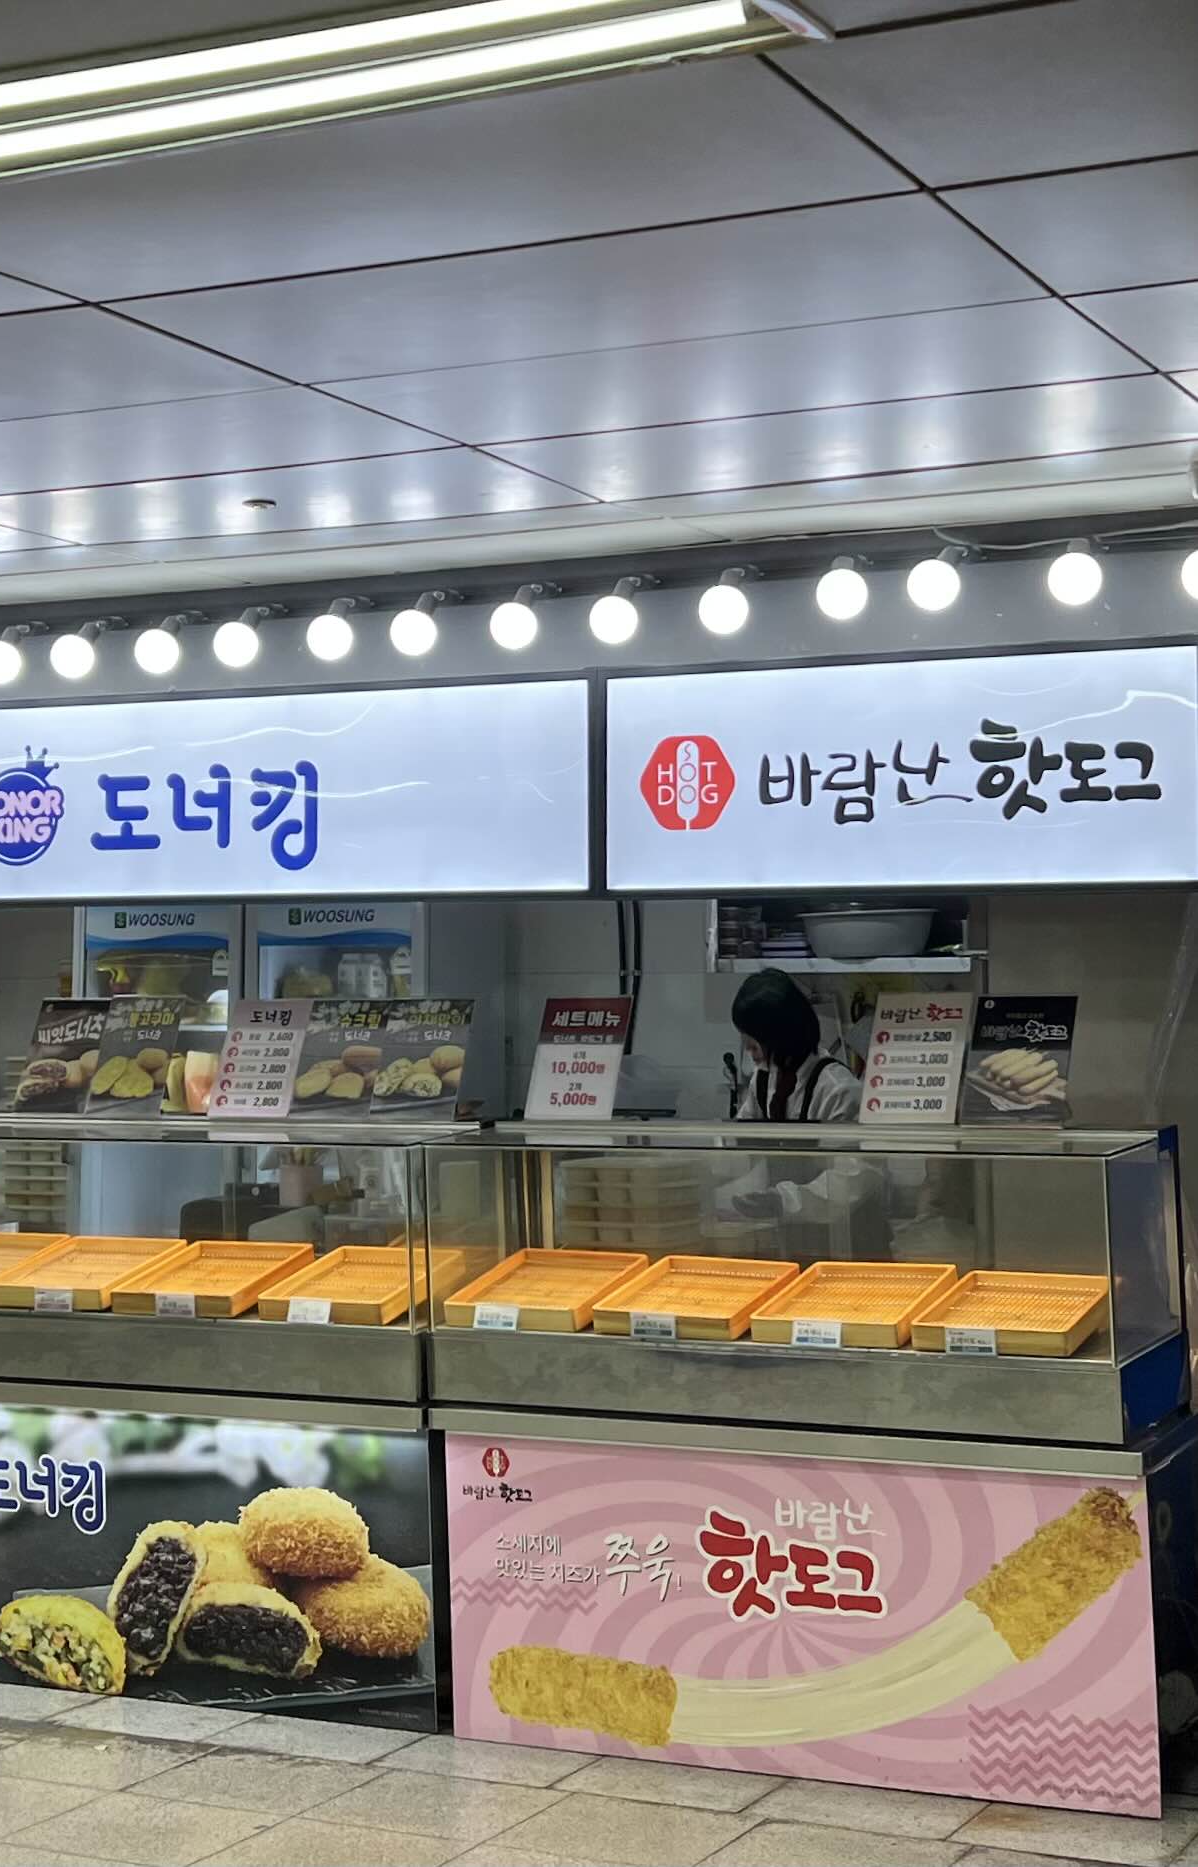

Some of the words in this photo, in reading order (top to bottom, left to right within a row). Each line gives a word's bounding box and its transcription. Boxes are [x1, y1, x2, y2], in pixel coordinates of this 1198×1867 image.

[657, 761, 718, 783] HOT
[759, 739, 973, 824] 바람난
[969, 718, 1161, 819] 핫도그
[658, 784, 718, 805] DOG
[91, 760, 318, 871] 도너킹
[128, 913, 195, 928] WOOSUNG
[303, 909, 376, 924] WOOSUNG
[250, 1010, 292, 1026] 도너킹
[551, 1010, 621, 1027] 세트메뉴
[880, 1007, 923, 1023] 바람난
[926, 1003, 963, 1022] 핫도그
[38, 1013, 105, 1044] 씨앗도너츠
[463, 1485, 499, 1500] 바람난
[499, 1482, 532, 1503] 핫도그
[775, 1498, 886, 1540] 바람난
[496, 1533, 562, 1556] 소세지에
[494, 1559, 546, 1583] 맛있는
[549, 1563, 601, 1587] 치즈가
[697, 1508, 885, 1620] 핫도그
